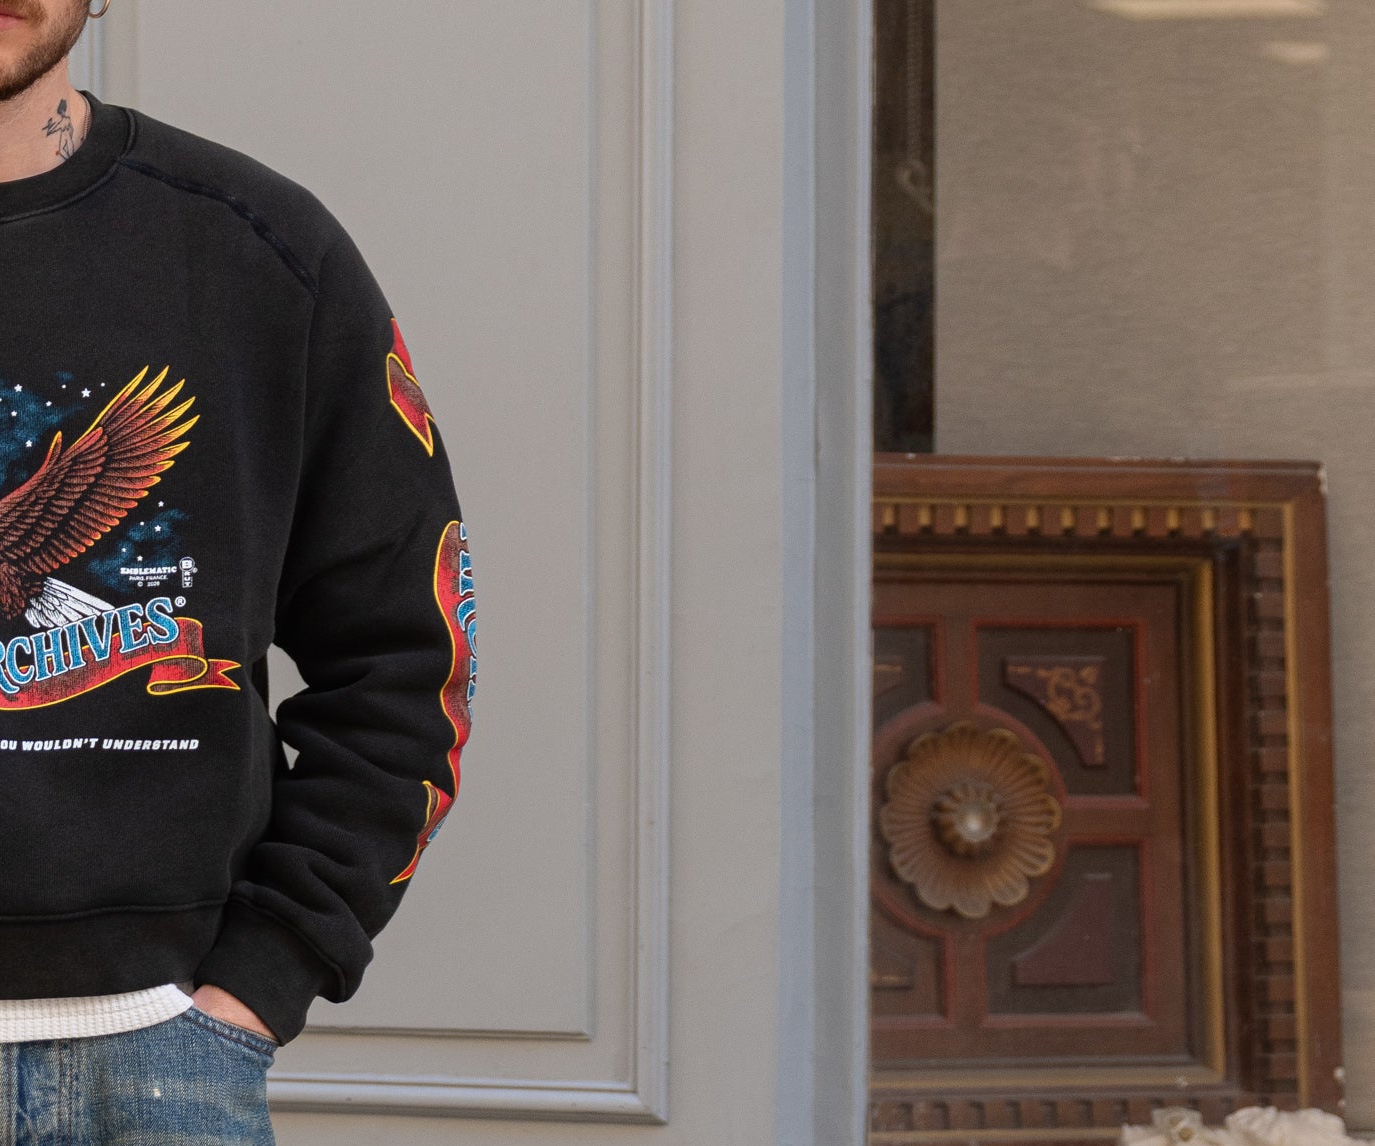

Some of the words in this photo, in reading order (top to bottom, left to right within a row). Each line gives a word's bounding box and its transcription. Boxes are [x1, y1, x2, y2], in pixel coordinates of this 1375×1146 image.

[120, 566, 177, 575] EMBLEMATIC
[22, 738, 98, 751] WOULDN'T
[102, 739, 199, 750] UNDERSTAND
